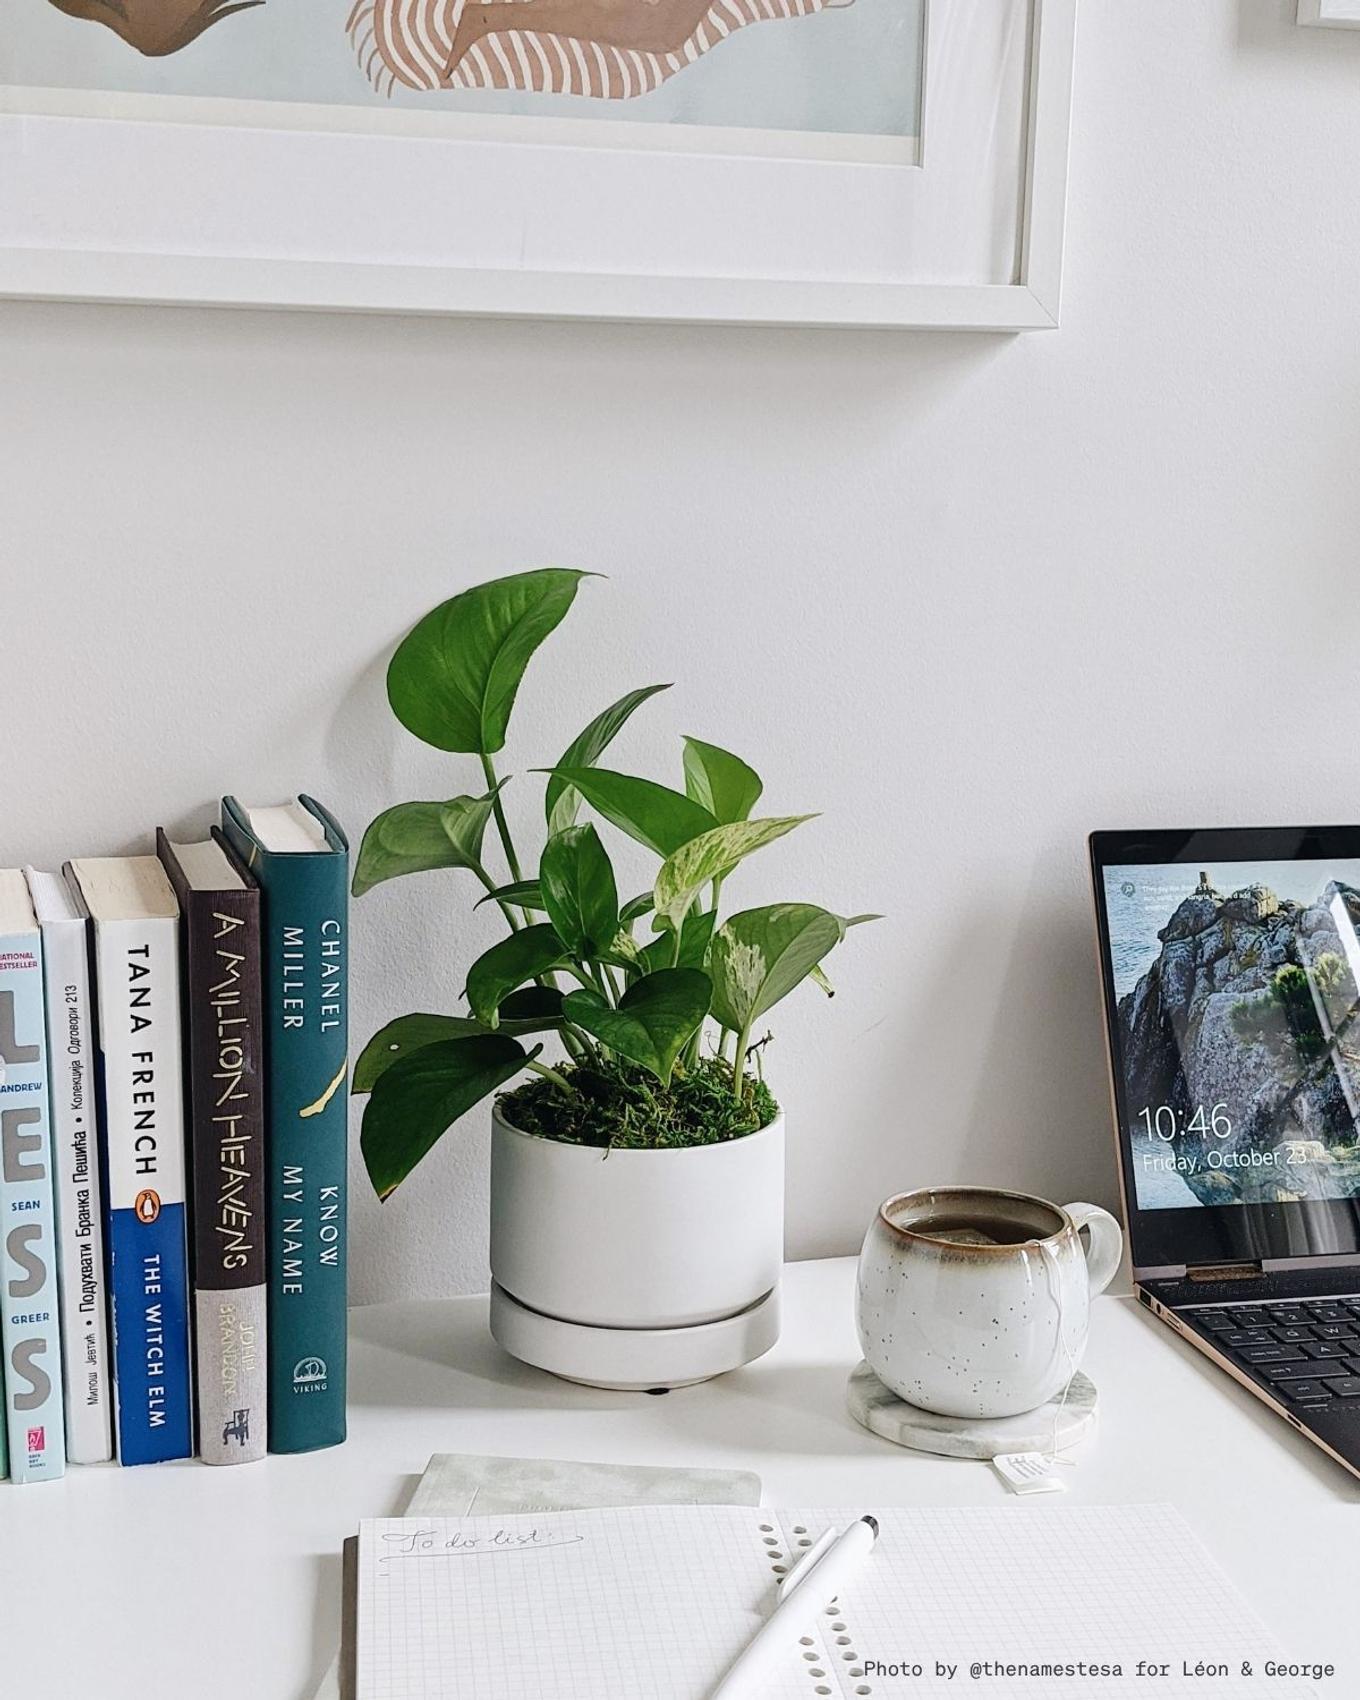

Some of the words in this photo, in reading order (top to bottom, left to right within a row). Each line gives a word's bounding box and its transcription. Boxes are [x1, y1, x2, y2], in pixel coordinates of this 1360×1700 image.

[212, 911, 245, 939] A
[65, 984, 78, 1002] 213
[127, 944, 152, 1034] TANA
[282, 926, 304, 1030] MILLER
[320, 919, 341, 1033] CHANEL
[67, 1004, 82, 1055] Одговори
[208, 949, 249, 1107] MILLION
[0, 1083, 42, 1093] ANDREW
[71, 1059, 83, 1111] Колекција
[131, 1051, 157, 1175] FRENCH
[1138, 1102, 1232, 1142] 10:46
[72, 1130, 88, 1184] Пешића
[1143, 1153, 1202, 1175] Friday,
[1207, 1146, 1281, 1169] October
[1286, 1146, 1307, 1165] 23
[11, 1200, 41, 1211] SEAN
[211, 1114, 253, 1270] HEAVENS
[282, 1165, 304, 1203] MY
[75, 1188, 92, 1236] Бранка
[319, 1185, 339, 1267] KNOW
[79, 1244, 97, 1313] Подухвати
[143, 1253, 160, 1294] THE
[282, 1217, 303, 1295] NAME
[11, 1312, 50, 1325] GREER
[145, 1303, 165, 1377] WITCH
[87, 1370, 99, 1407] Милош
[148, 1386, 166, 1428] ELM
[293, 1382, 328, 1393] VIKING
[382, 1530, 437, 1553] To
[445, 1532, 480, 1549] do
